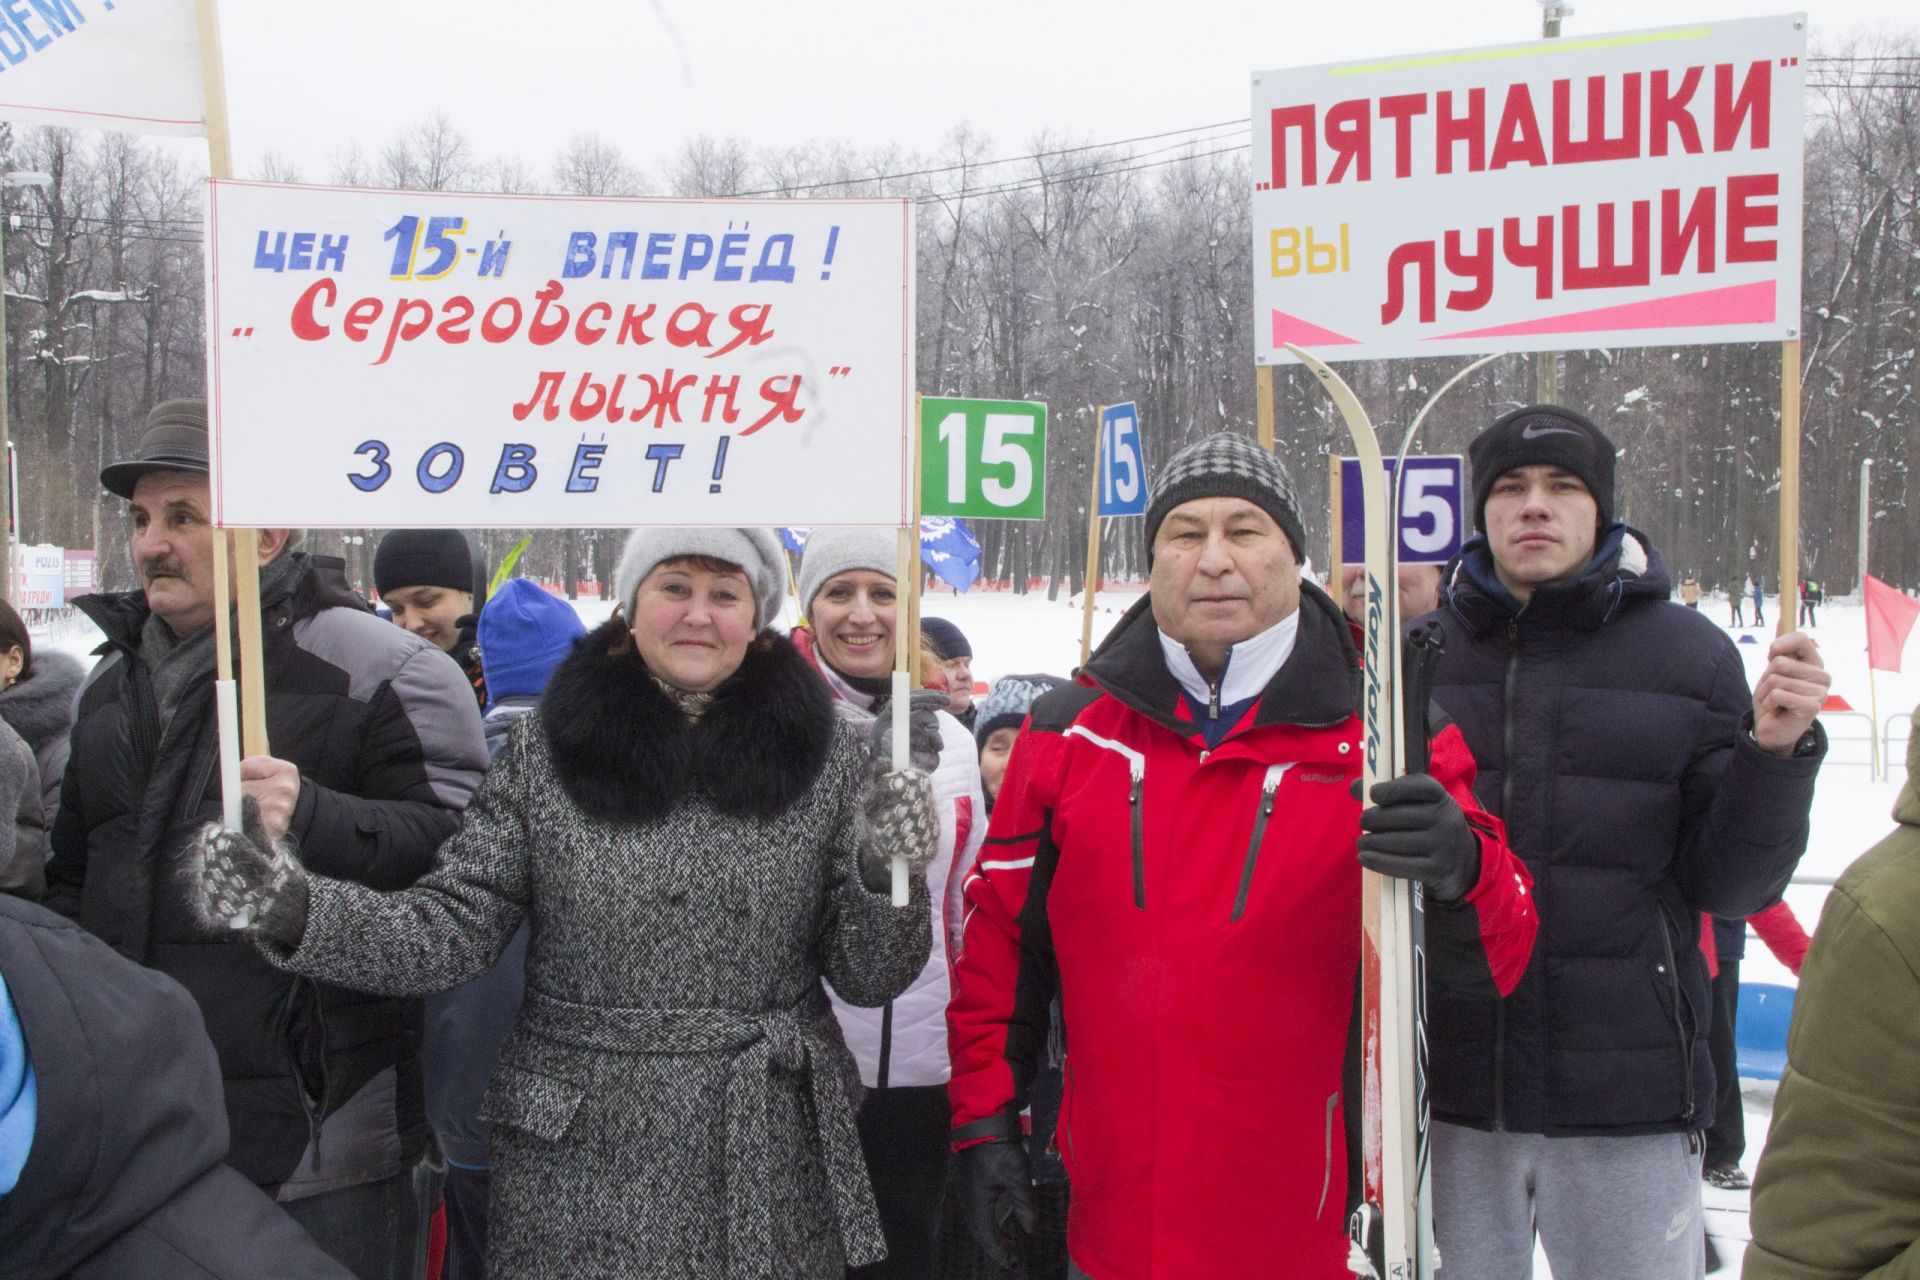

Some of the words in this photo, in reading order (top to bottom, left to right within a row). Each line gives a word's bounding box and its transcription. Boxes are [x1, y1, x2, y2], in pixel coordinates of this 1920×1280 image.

[1270, 223, 1350, 279] ВЫ
[1381, 173, 1779, 326] ЛУЧШИЕ
[938, 412, 1034, 507] 15
[1100, 416, 1140, 504] 15
[1366, 571, 1383, 778] Karjala
[1757, 993, 1767, 1005] 7
